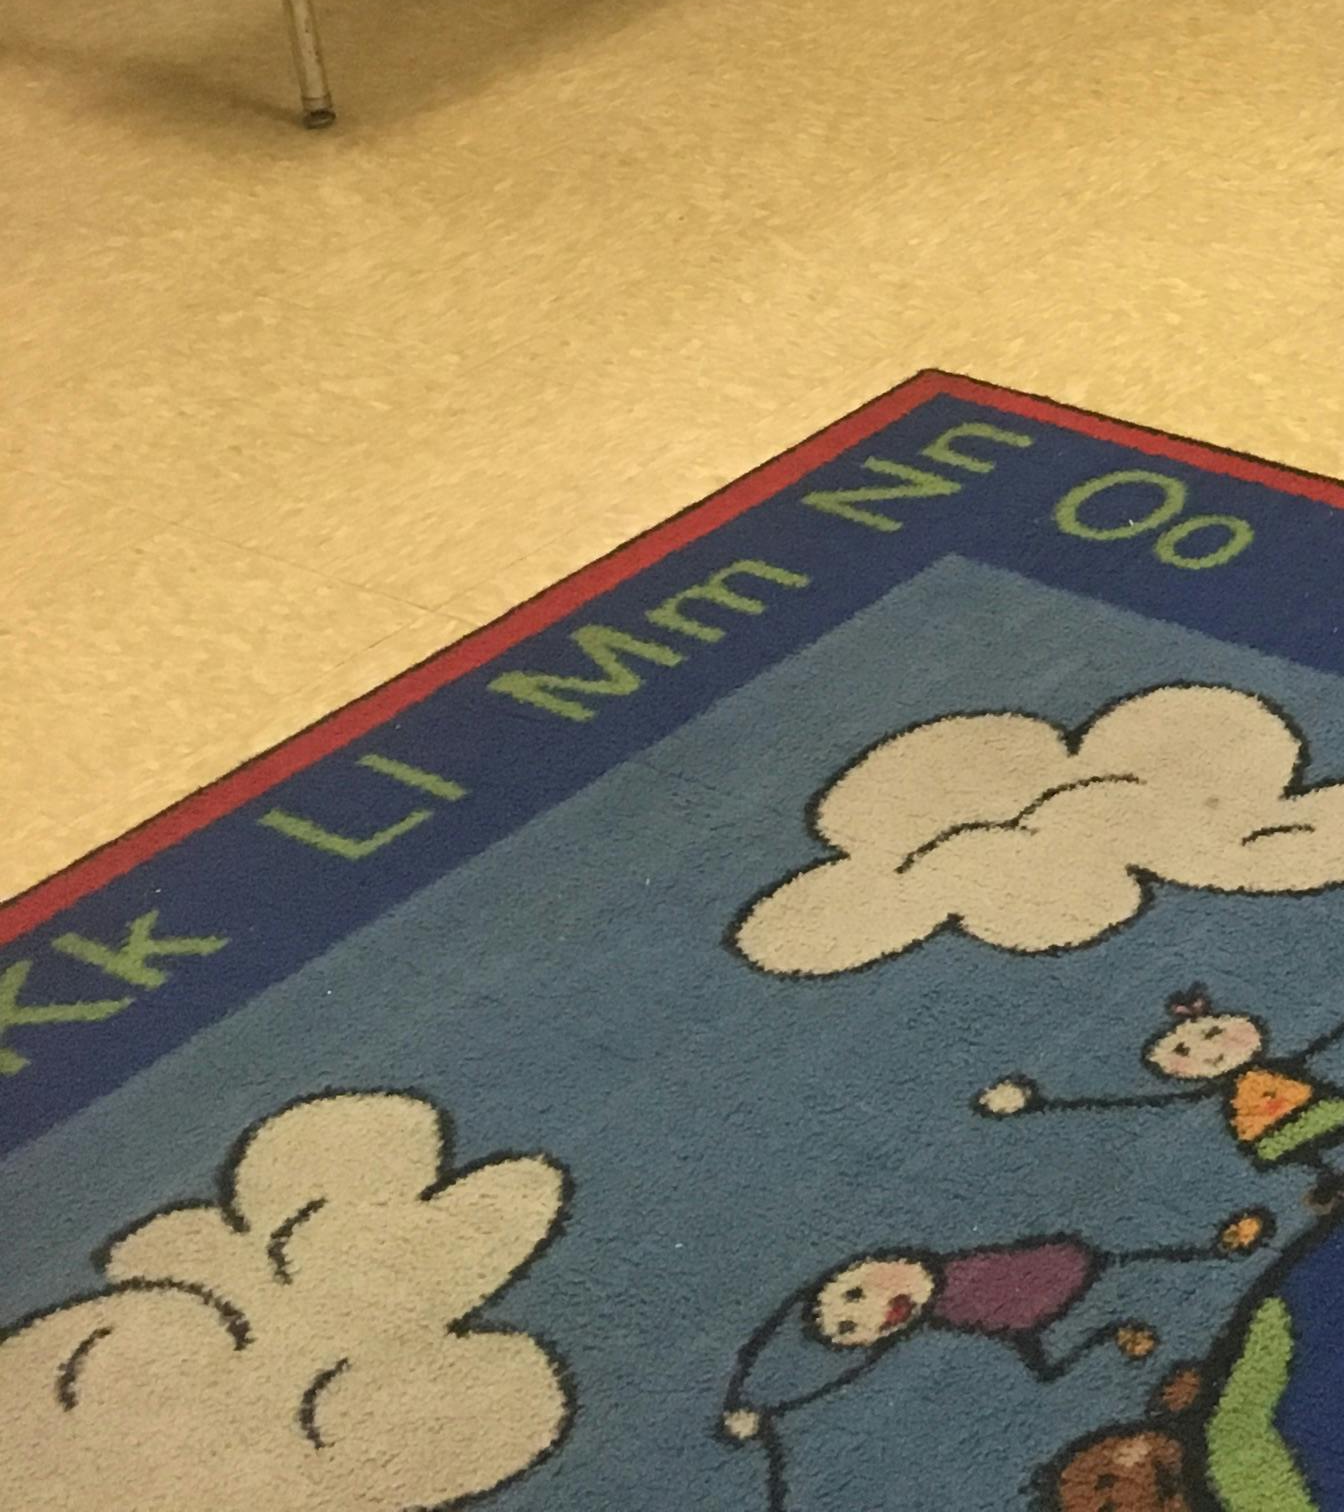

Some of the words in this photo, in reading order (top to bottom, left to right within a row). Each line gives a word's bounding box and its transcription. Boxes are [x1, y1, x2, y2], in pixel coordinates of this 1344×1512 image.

[257, 753, 469, 861] Ll
[486, 557, 810, 723] Mm
[801, 419, 1034, 533] Nn
[1051, 469, 1256, 570] Oo
